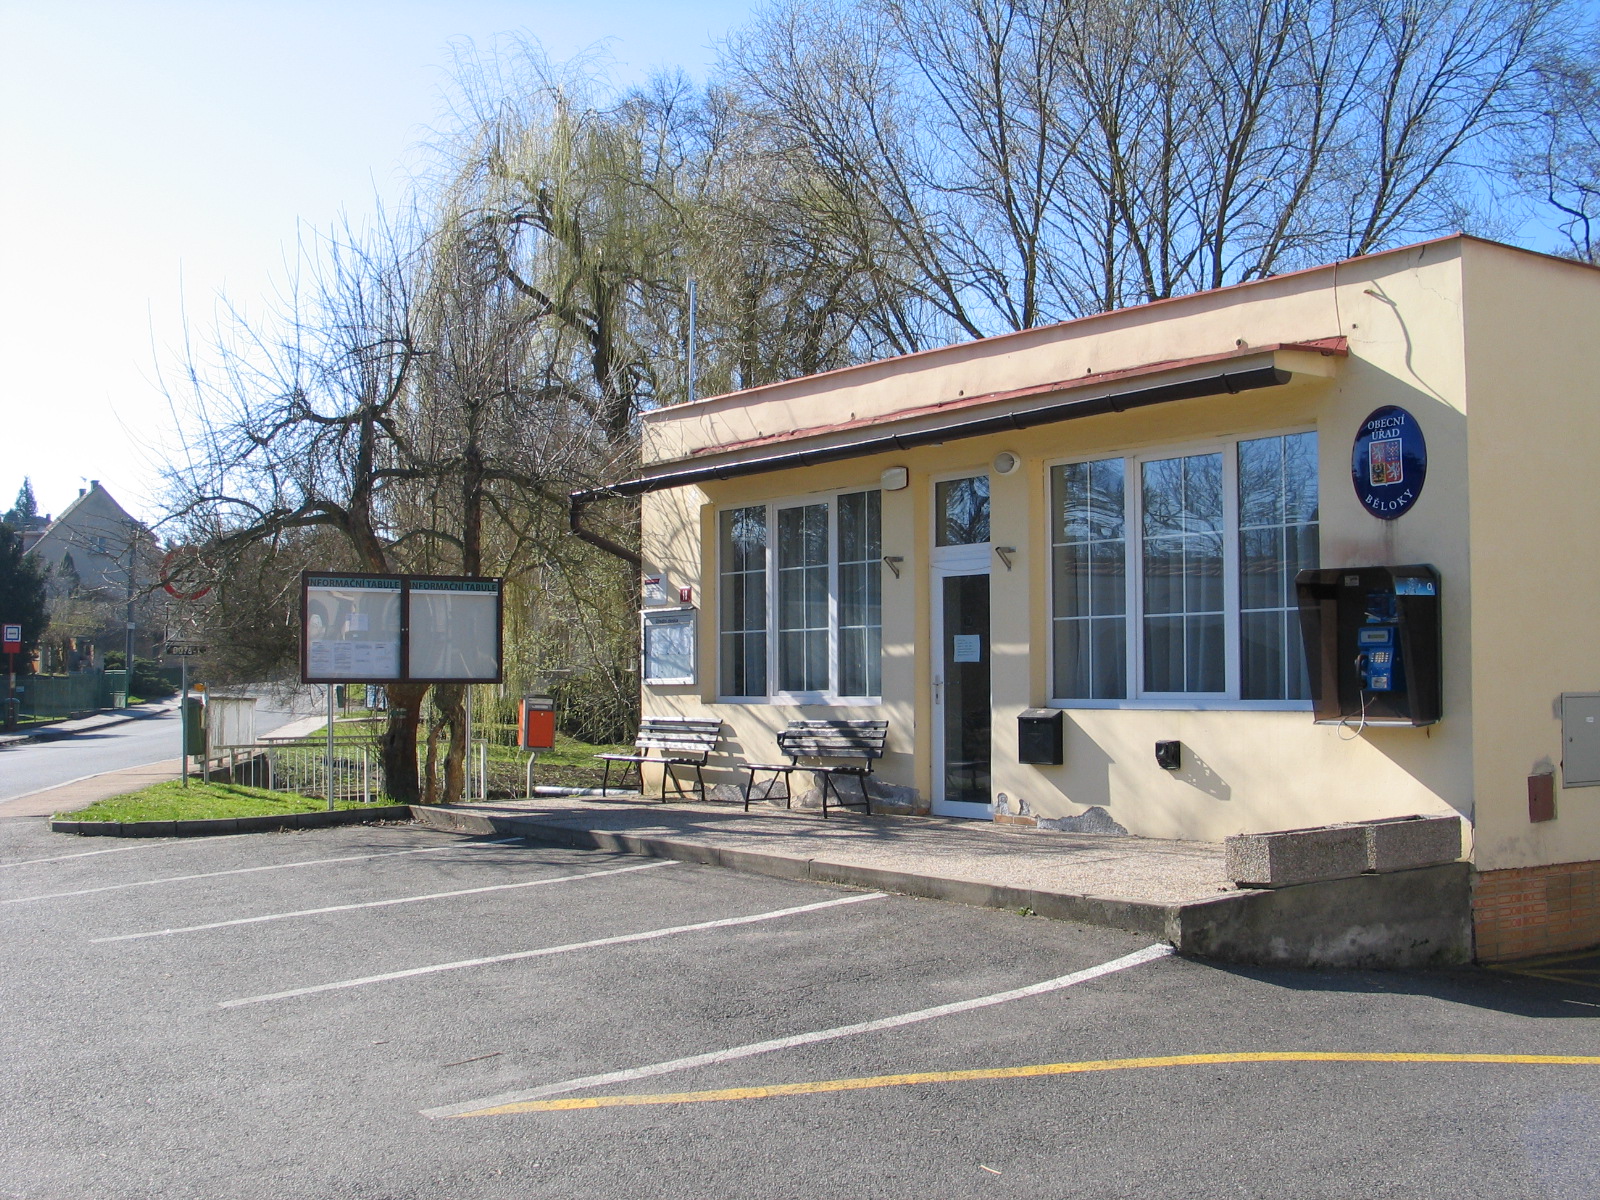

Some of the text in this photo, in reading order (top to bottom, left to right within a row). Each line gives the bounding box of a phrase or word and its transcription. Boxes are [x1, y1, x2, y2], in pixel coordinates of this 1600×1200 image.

[1367, 414, 1405, 430] OBECNÍ
[1371, 428, 1400, 440] ÚŘAD
[1365, 489, 1413, 511] BĚLOKY
[367, 579, 400, 589] TABULE
[465, 583, 497, 592] TABULE
